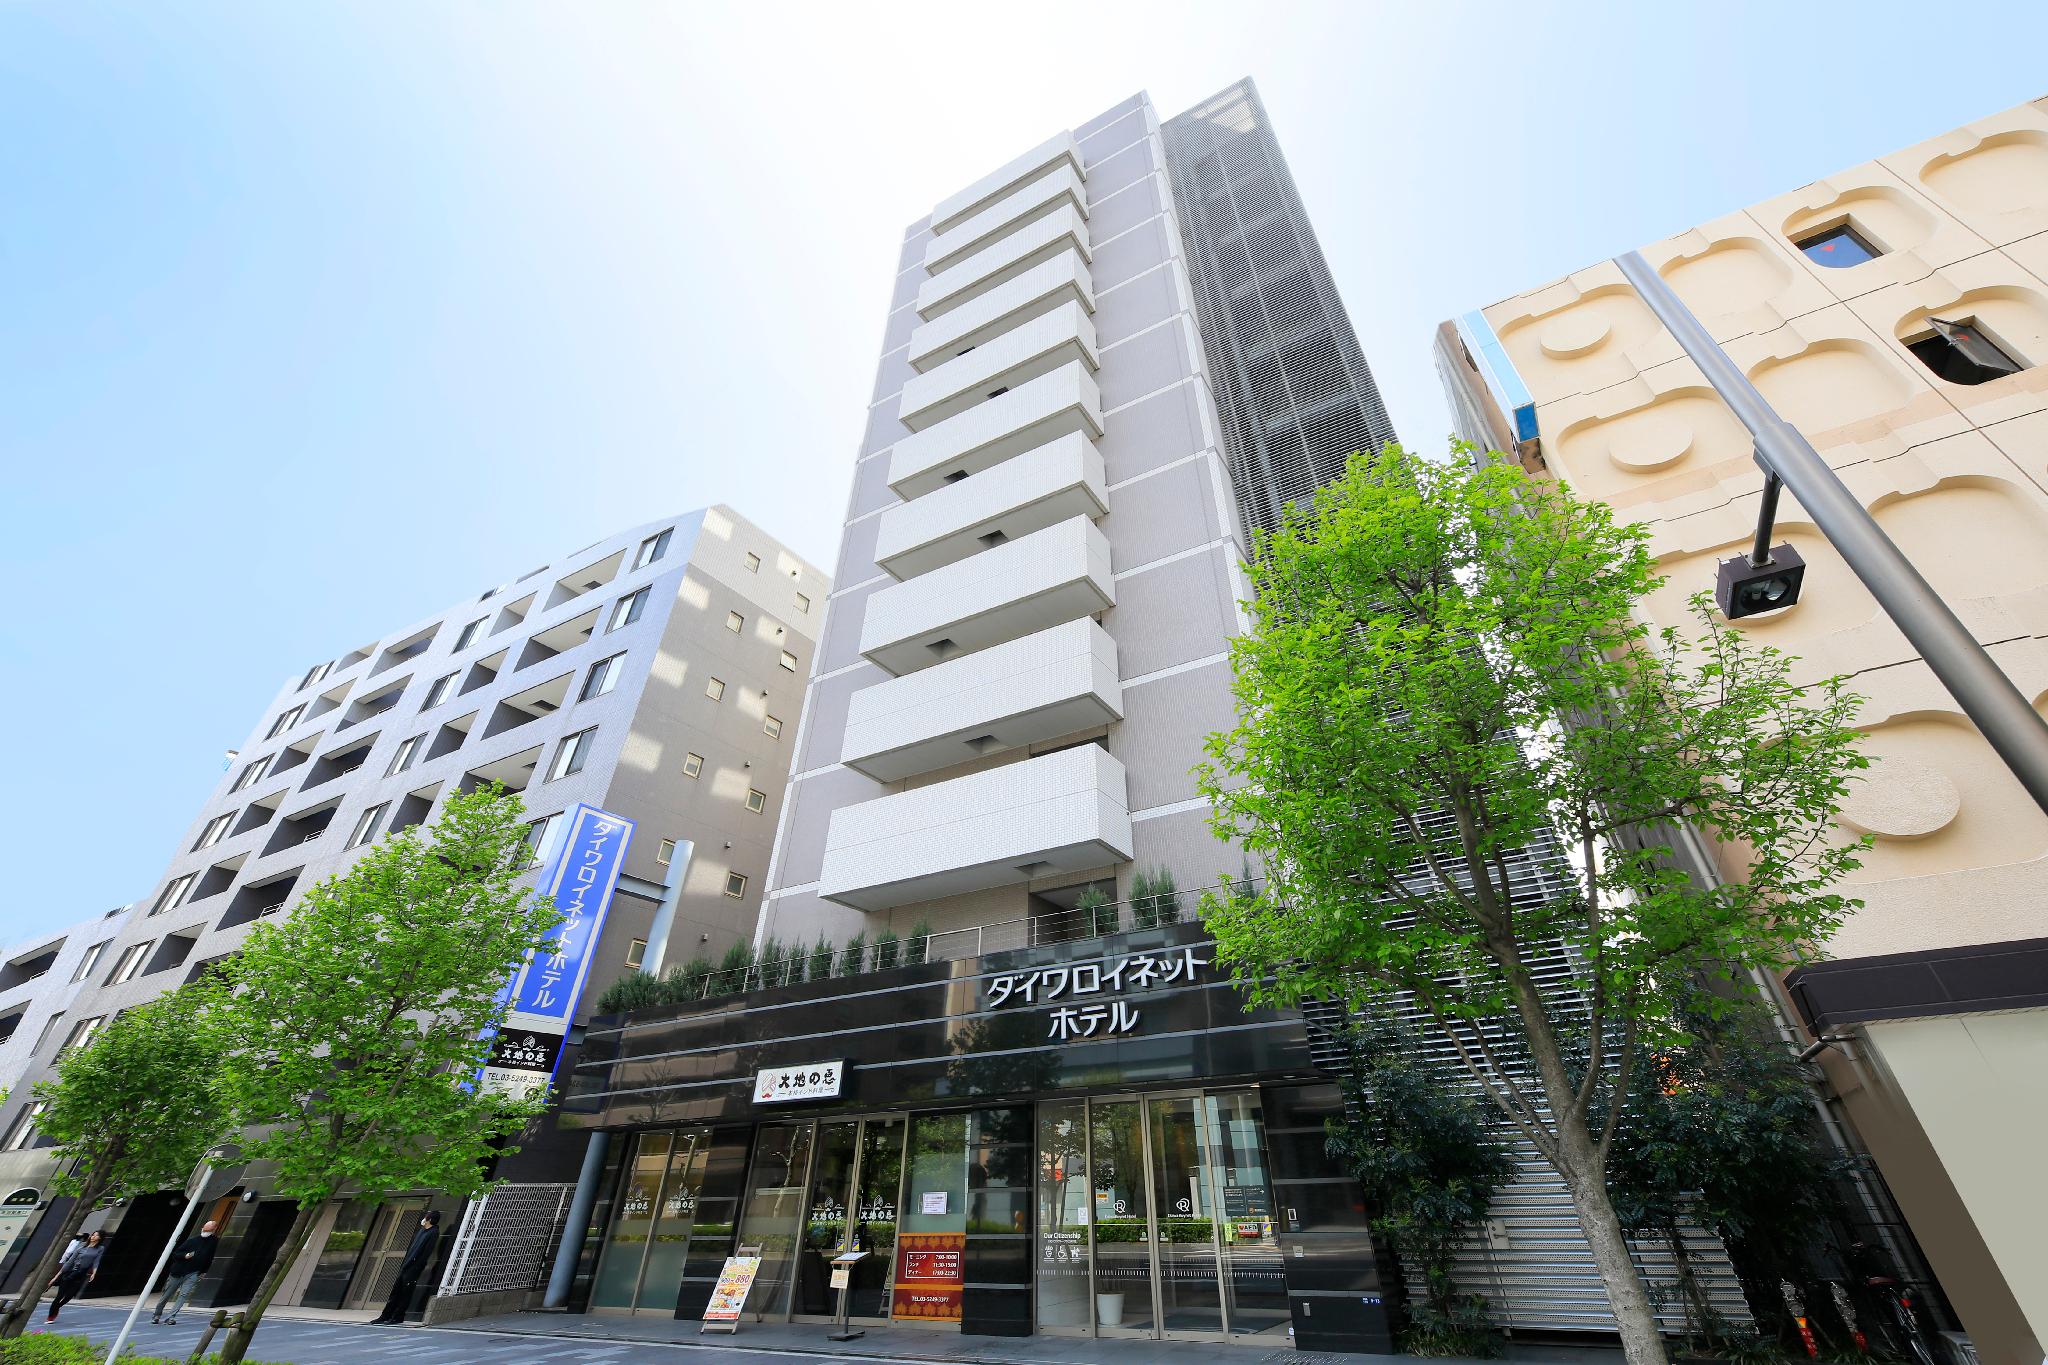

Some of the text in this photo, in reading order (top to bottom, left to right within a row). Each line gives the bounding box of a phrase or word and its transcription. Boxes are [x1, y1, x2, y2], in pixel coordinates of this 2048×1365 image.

[531, 821, 619, 1008] ダイワロイネットホテル
[988, 949, 1208, 1008] ダイワロイネット
[1048, 1001, 1139, 1039] ホテル
[778, 1068, 836, 1089] 大地の恵
